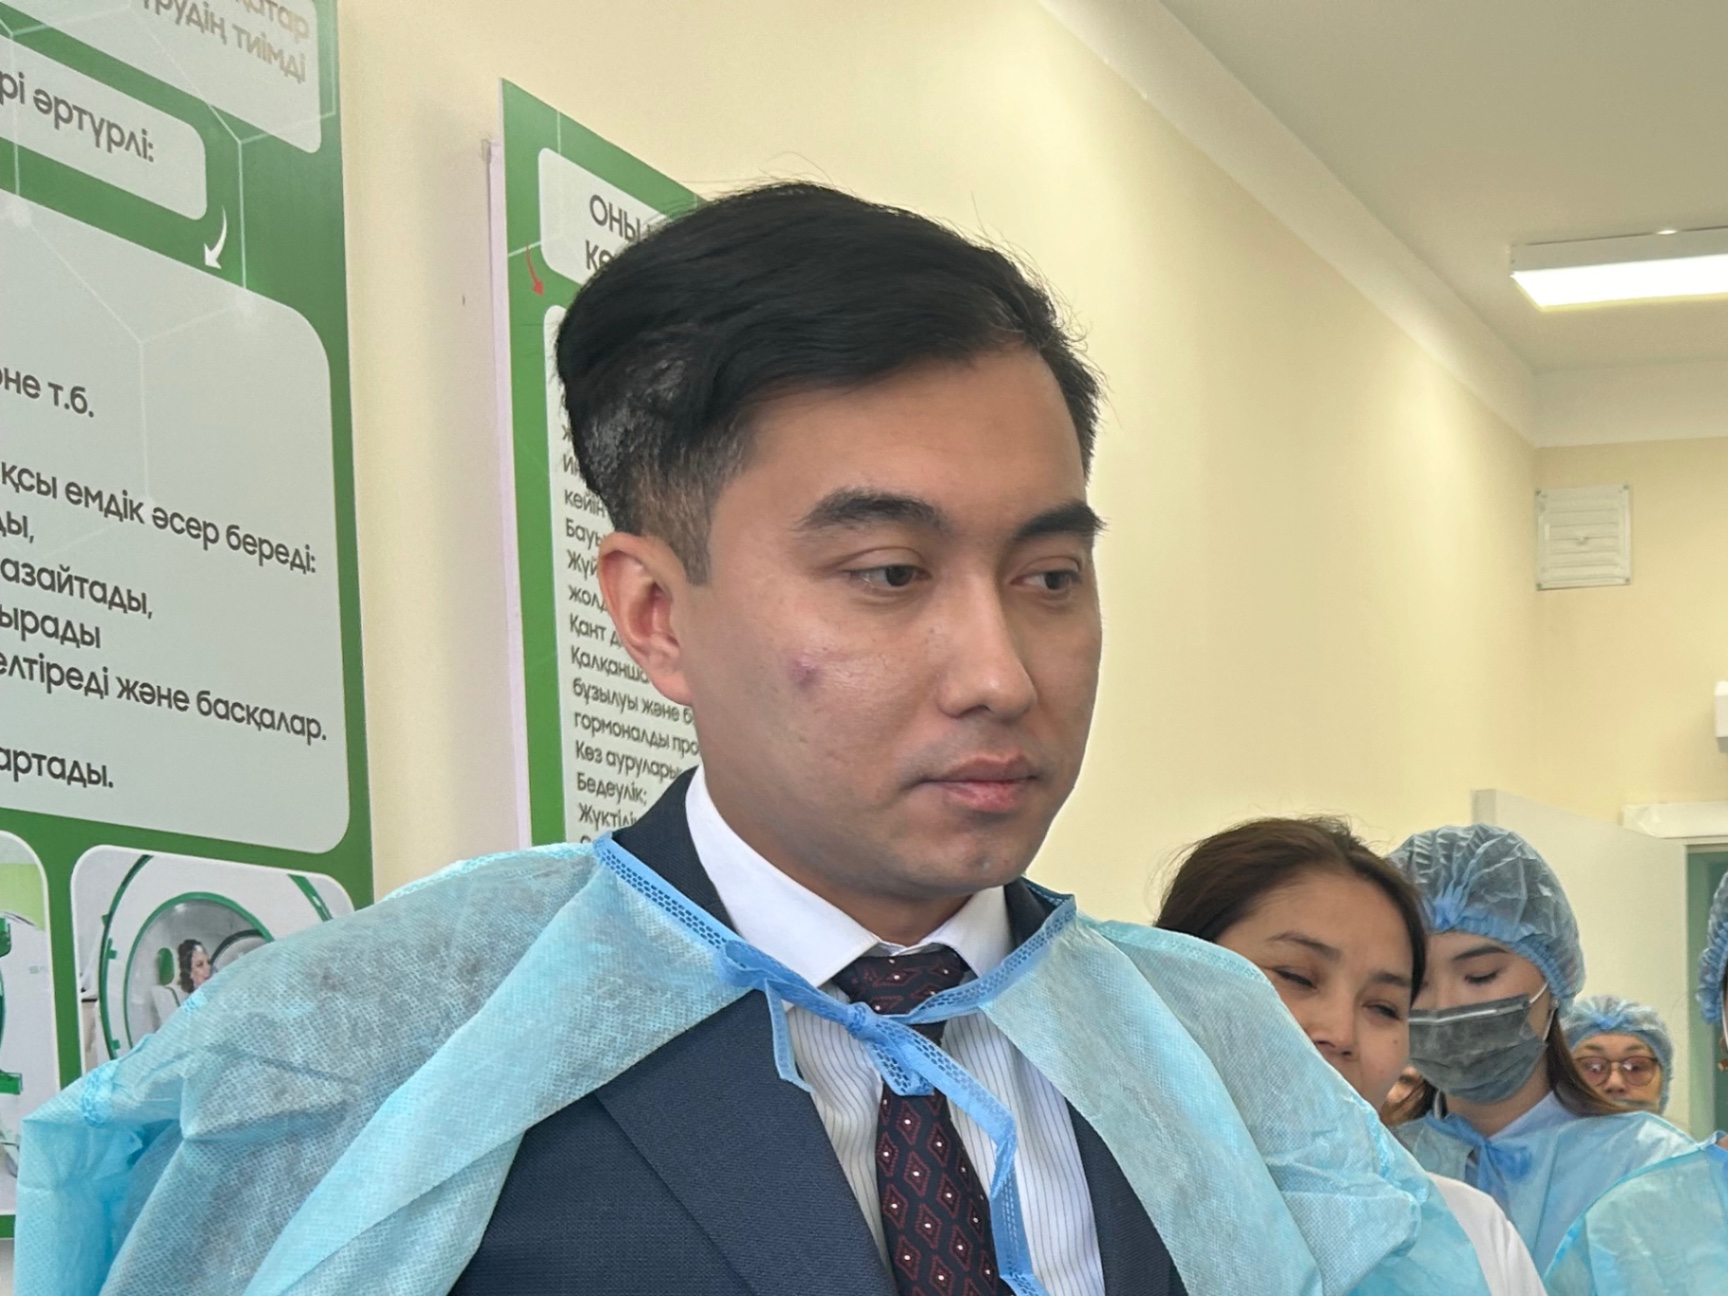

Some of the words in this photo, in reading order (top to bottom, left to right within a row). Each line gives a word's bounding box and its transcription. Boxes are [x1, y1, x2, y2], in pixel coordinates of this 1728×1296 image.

[232, 24, 306, 84] тиімді
[33, 88, 154, 162] әртүрлі:
[0, 366, 41, 399] не
[48, 381, 94, 418] т.б.
[1, 461, 57, 499] қсы
[65, 481, 145, 524] емдік
[152, 507, 219, 551] әсер
[226, 524, 316, 575] береді:
[0, 558, 152, 619] азайтады,
[569, 612, 606, 641] Қант
[116, 676, 190, 712] және
[196, 690, 327, 746] басқалар.
[574, 711, 669, 749] гормоналды
[642, 698, 680, 722] және
[575, 740, 603, 764] Көз
[577, 772, 647, 805] Бедеулік;
